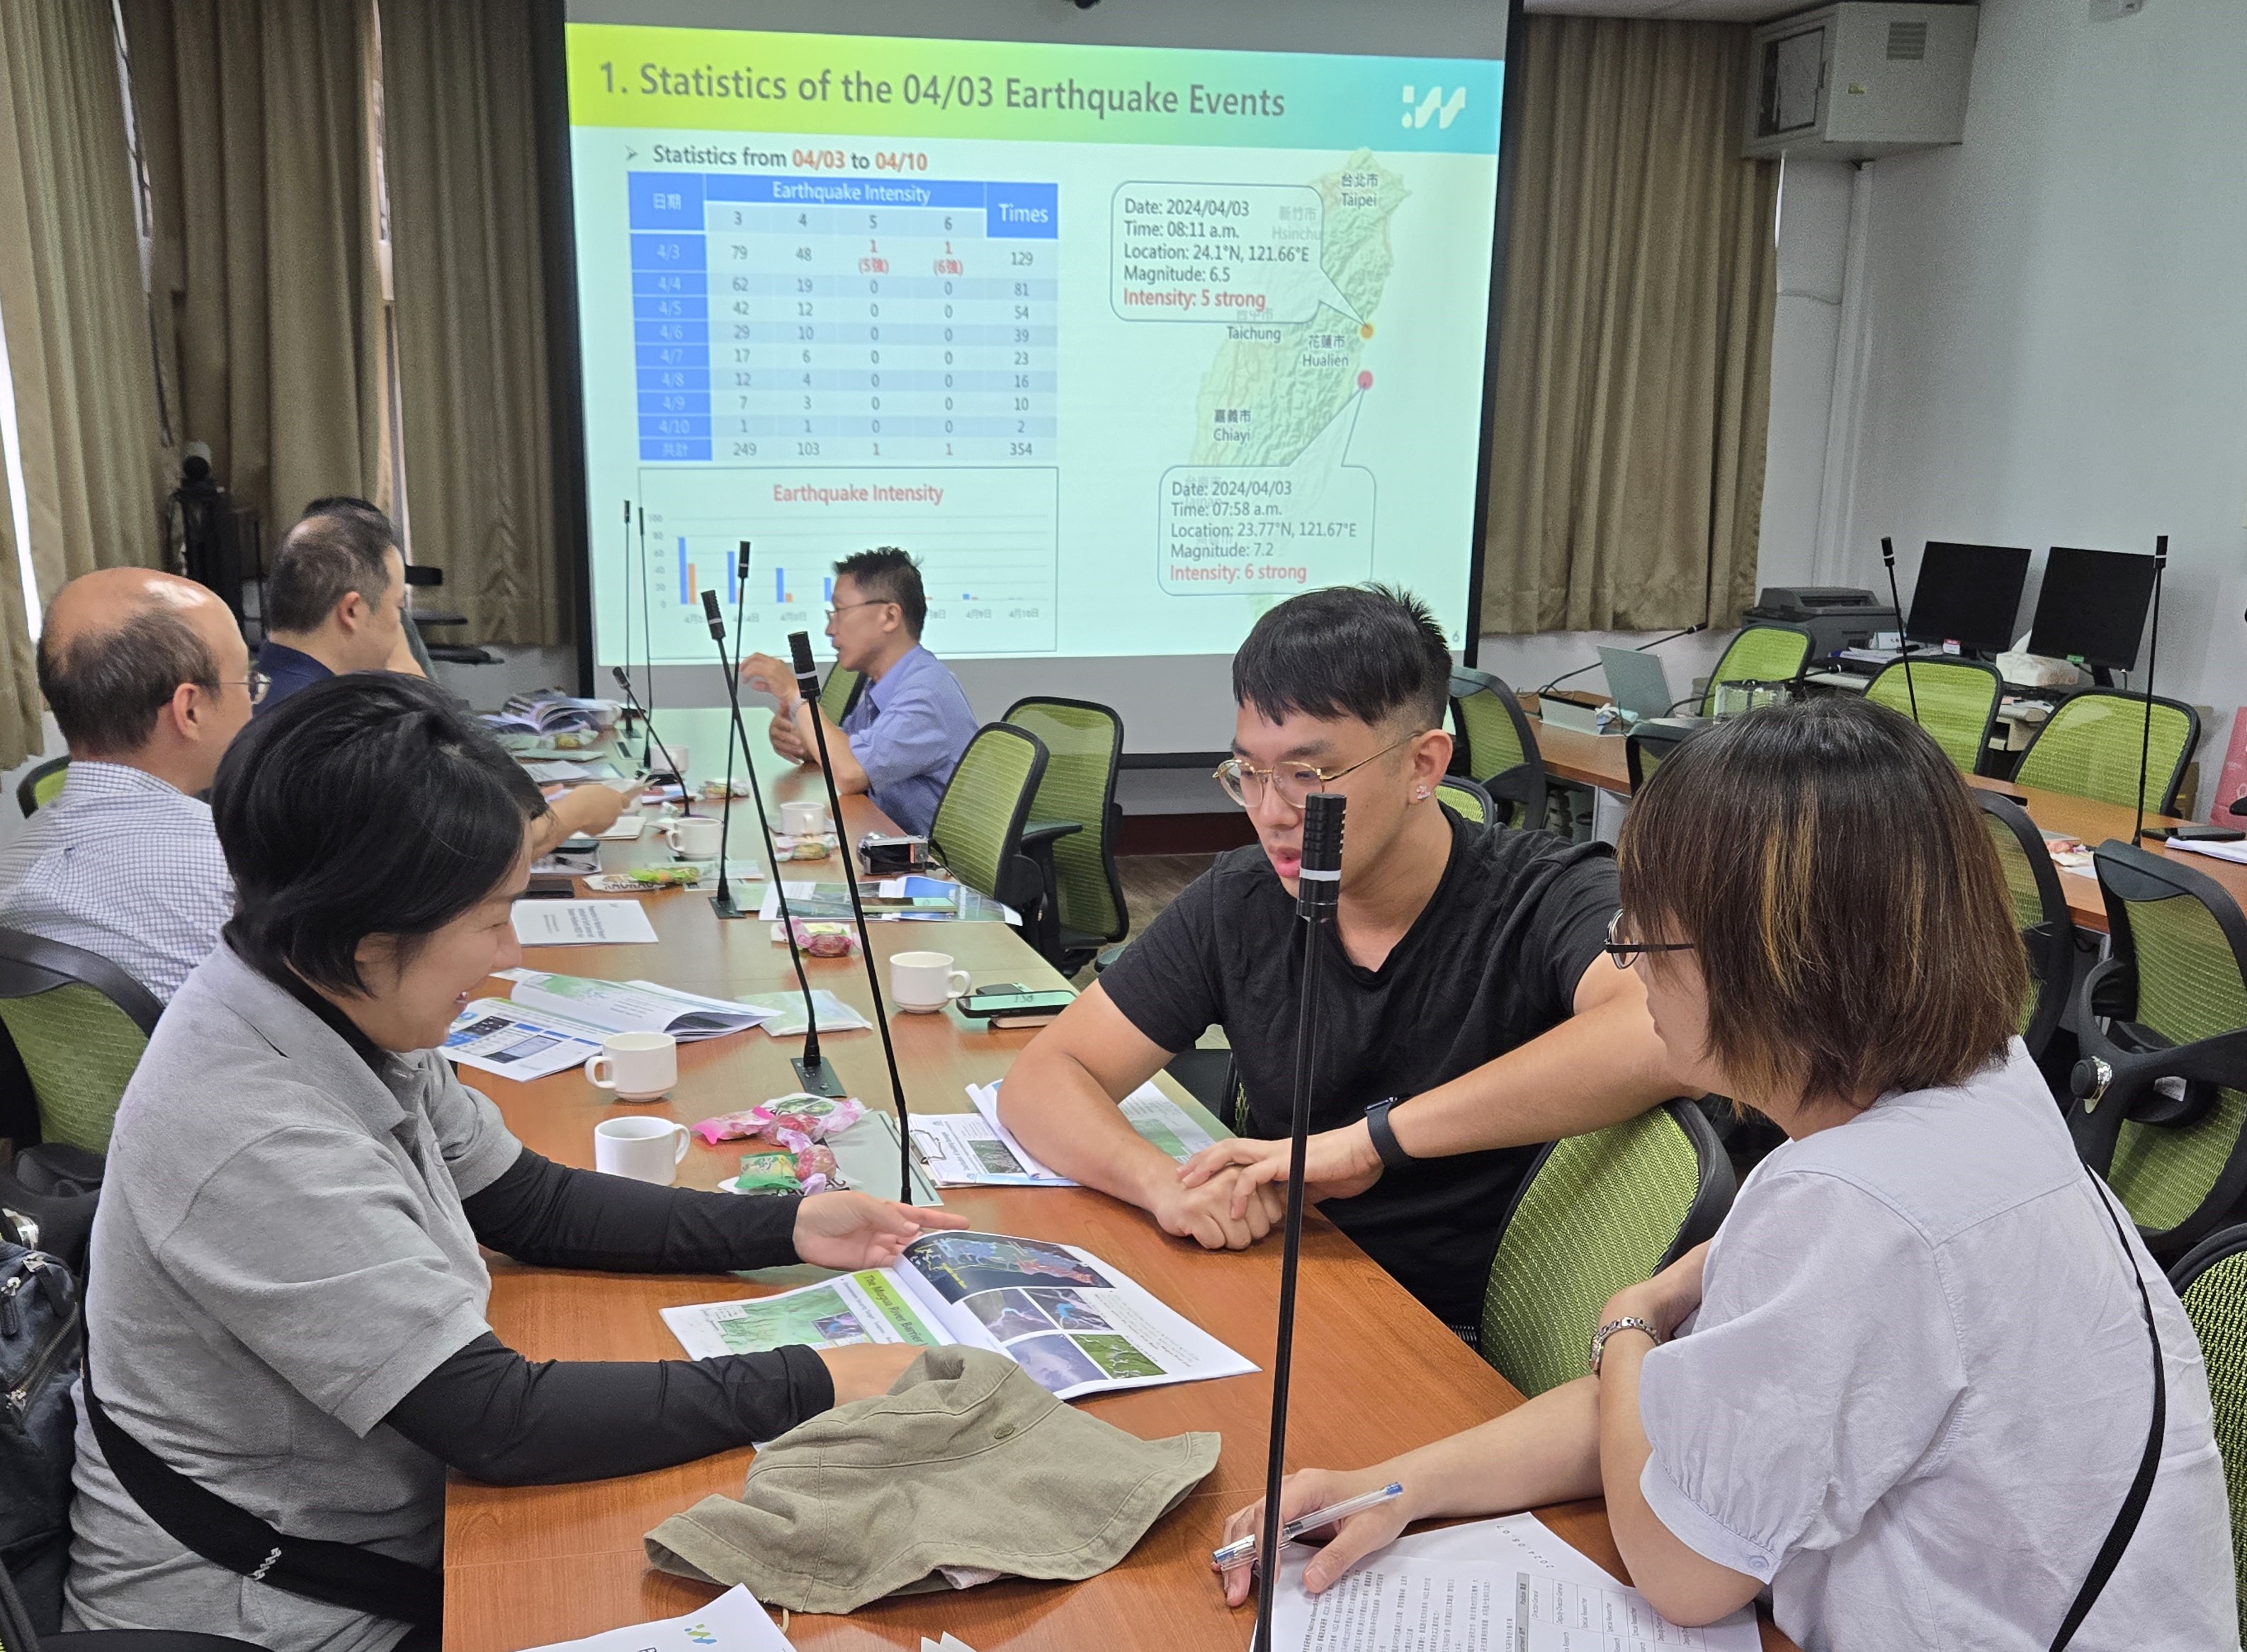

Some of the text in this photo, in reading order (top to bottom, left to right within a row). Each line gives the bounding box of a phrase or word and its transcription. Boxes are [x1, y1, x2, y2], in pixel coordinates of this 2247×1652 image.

[601, 62, 1285, 120] 1. Statistics of the 04/03 Earthquake Events
[653, 145, 928, 173] Statistics from 04/03 to 04/10
[772, 181, 931, 206] Earthquake Intensity
[1342, 193, 1376, 210] Taipei
[998, 203, 1048, 223] Times
[1124, 198, 1250, 217] Date: 2024/04/03
[734, 212, 952, 231] 3 4 5 6
[1124, 220, 1239, 239] Time: 08:11 a.m.
[731, 245, 748, 260] 79
[796, 247, 812, 261] 48
[871, 239, 877, 254] 1
[945, 241, 952, 254] 1
[1011, 251, 1033, 266] 129
[1124, 243, 1309, 263] Location: 24.1°N, 121.66°E
[1124, 266, 1230, 285] Magnitude: 6.5
[732, 277, 748, 292] 62
[798, 278, 813, 293] 19
[870, 279, 878, 294] 0
[944, 281, 953, 295] 0
[1014, 282, 1029, 296] 81
[1124, 288, 1265, 312] Intensity: 5 strong
[733, 301, 749, 315] 42
[798, 302, 813, 317] 12
[871, 302, 879, 318] 0
[944, 304, 953, 319] 0
[1014, 305, 1029, 319] 54
[734, 325, 750, 339] 29
[798, 326, 814, 341] 10
[871, 327, 879, 341] 0
[944, 327, 953, 342] 0
[1014, 328, 1029, 343] 39
[1227, 326, 1281, 343] Taichung
[735, 349, 750, 363] 17
[802, 349, 811, 363] 6
[871, 349, 880, 364] 0
[944, 351, 953, 365] 0
[1014, 351, 1029, 366] 23
[1303, 354, 1349, 367] Hualien
[735, 372, 751, 387] 12
[803, 373, 811, 387] 4
[871, 373, 880, 388] 0
[944, 373, 953, 388] 0
[1014, 375, 1029, 388] 16
[739, 395, 748, 410] 7
[803, 396, 812, 410] 3
[871, 396, 880, 411] 0
[944, 397, 953, 411] 0
[1014, 397, 1029, 411] 10
[740, 419, 748, 434] 1
[805, 419, 812, 434] 1
[872, 419, 880, 434] 0
[944, 419, 953, 434] 0
[1017, 420, 1025, 434] 2
[1213, 428, 1250, 445] Chiayi
[733, 442, 757, 456] 249
[797, 441, 820, 456] 103
[873, 443, 880, 456] 1
[946, 443, 953, 456] 1
[1009, 443, 1032, 456] 354
[773, 483, 944, 507] Earthquake Intensity
[1172, 482, 1208, 496] Date:
[1212, 480, 1291, 497] 2024/04/03
[1171, 502, 1282, 516] Time: 07:58 a.m.
[1171, 522, 1357, 538] Location: 23.77°N, 121.67°E
[1170, 543, 1274, 561] Magnitude: 7.2
[1170, 564, 1307, 584] Intensity: 6 strong
[864, 1275, 876, 1286] The
[888, 1306, 906, 1322] River
[901, 1322, 923, 1343] Barrier
